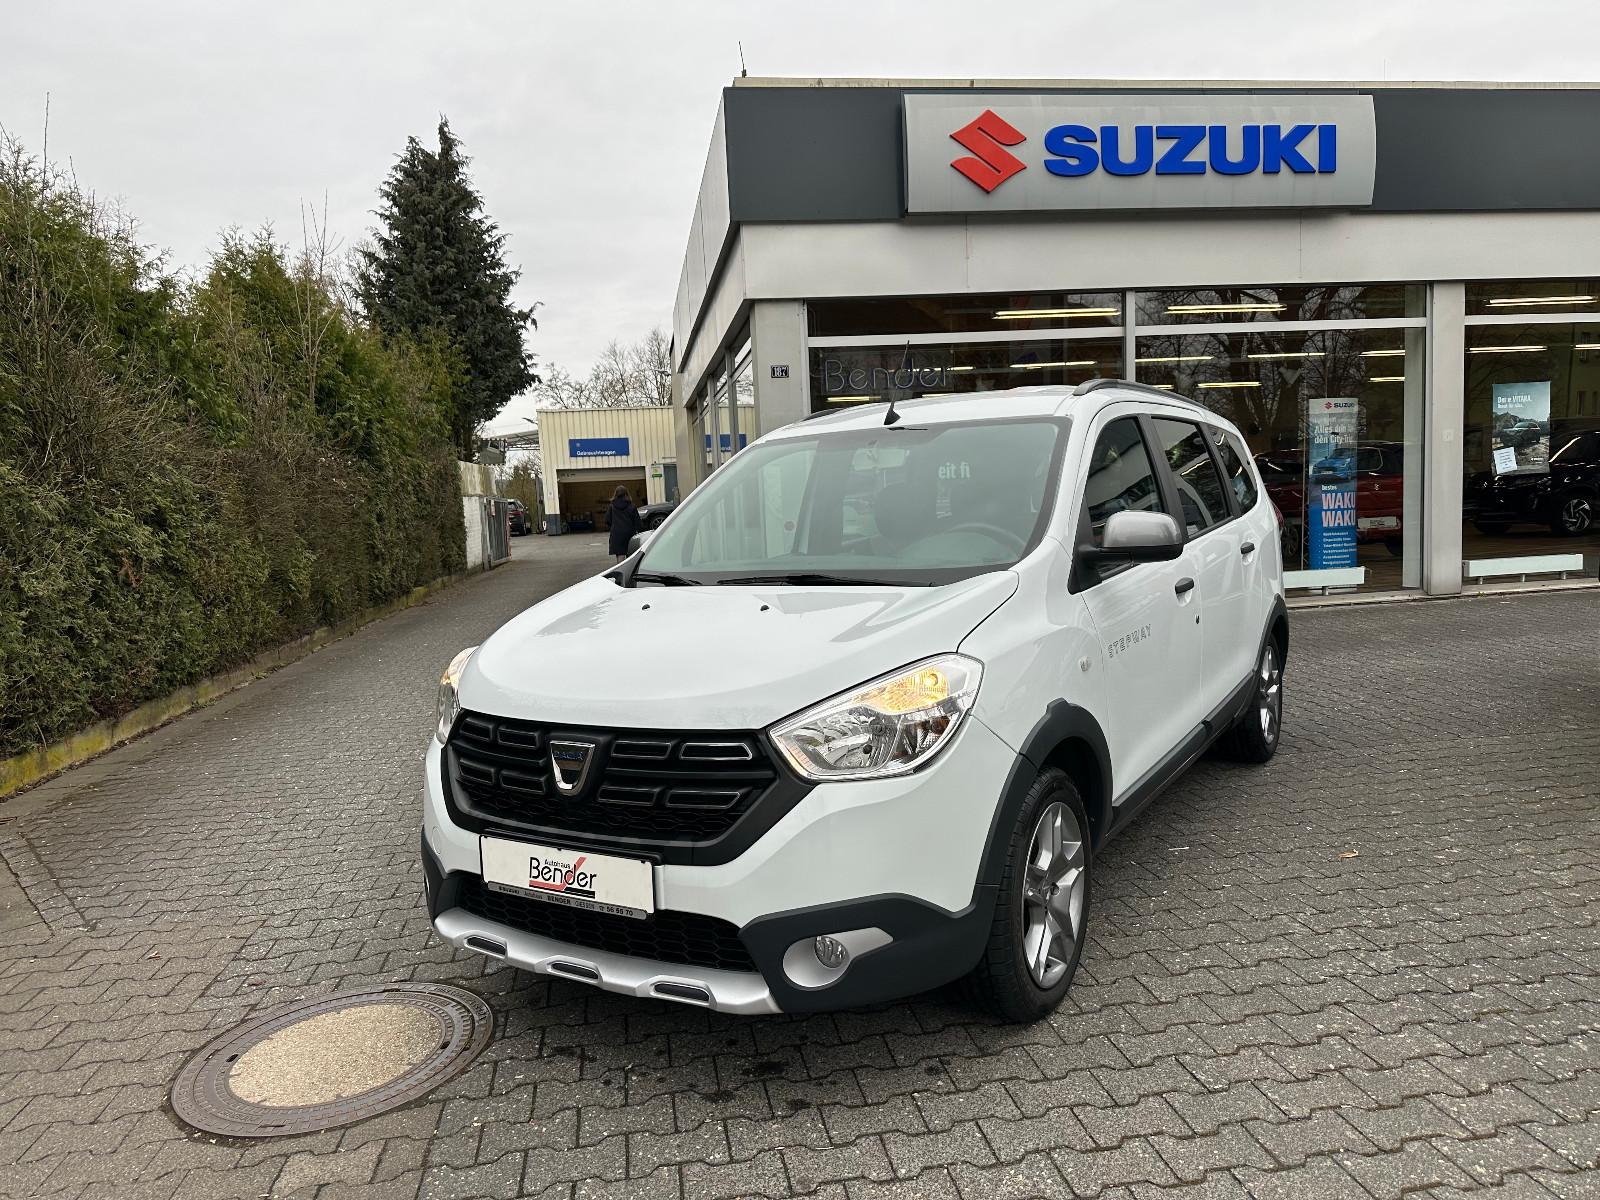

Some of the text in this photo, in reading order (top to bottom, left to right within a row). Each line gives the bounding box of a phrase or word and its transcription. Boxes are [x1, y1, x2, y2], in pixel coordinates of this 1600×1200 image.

[1044, 124, 1337, 176] SUZUKI
[825, 357, 951, 392] Bender
[1314, 425, 1332, 434] Alles
[1314, 435, 1328, 444] den
[938, 462, 956, 479] eit
[1321, 492, 1356, 509] WAKU
[1321, 510, 1356, 527] WAKU
[1107, 624, 1151, 658] STEPWAY
[544, 858, 571, 869] Autohaus
[529, 856, 597, 889] Bender
[547, 895, 571, 905] BENDER
